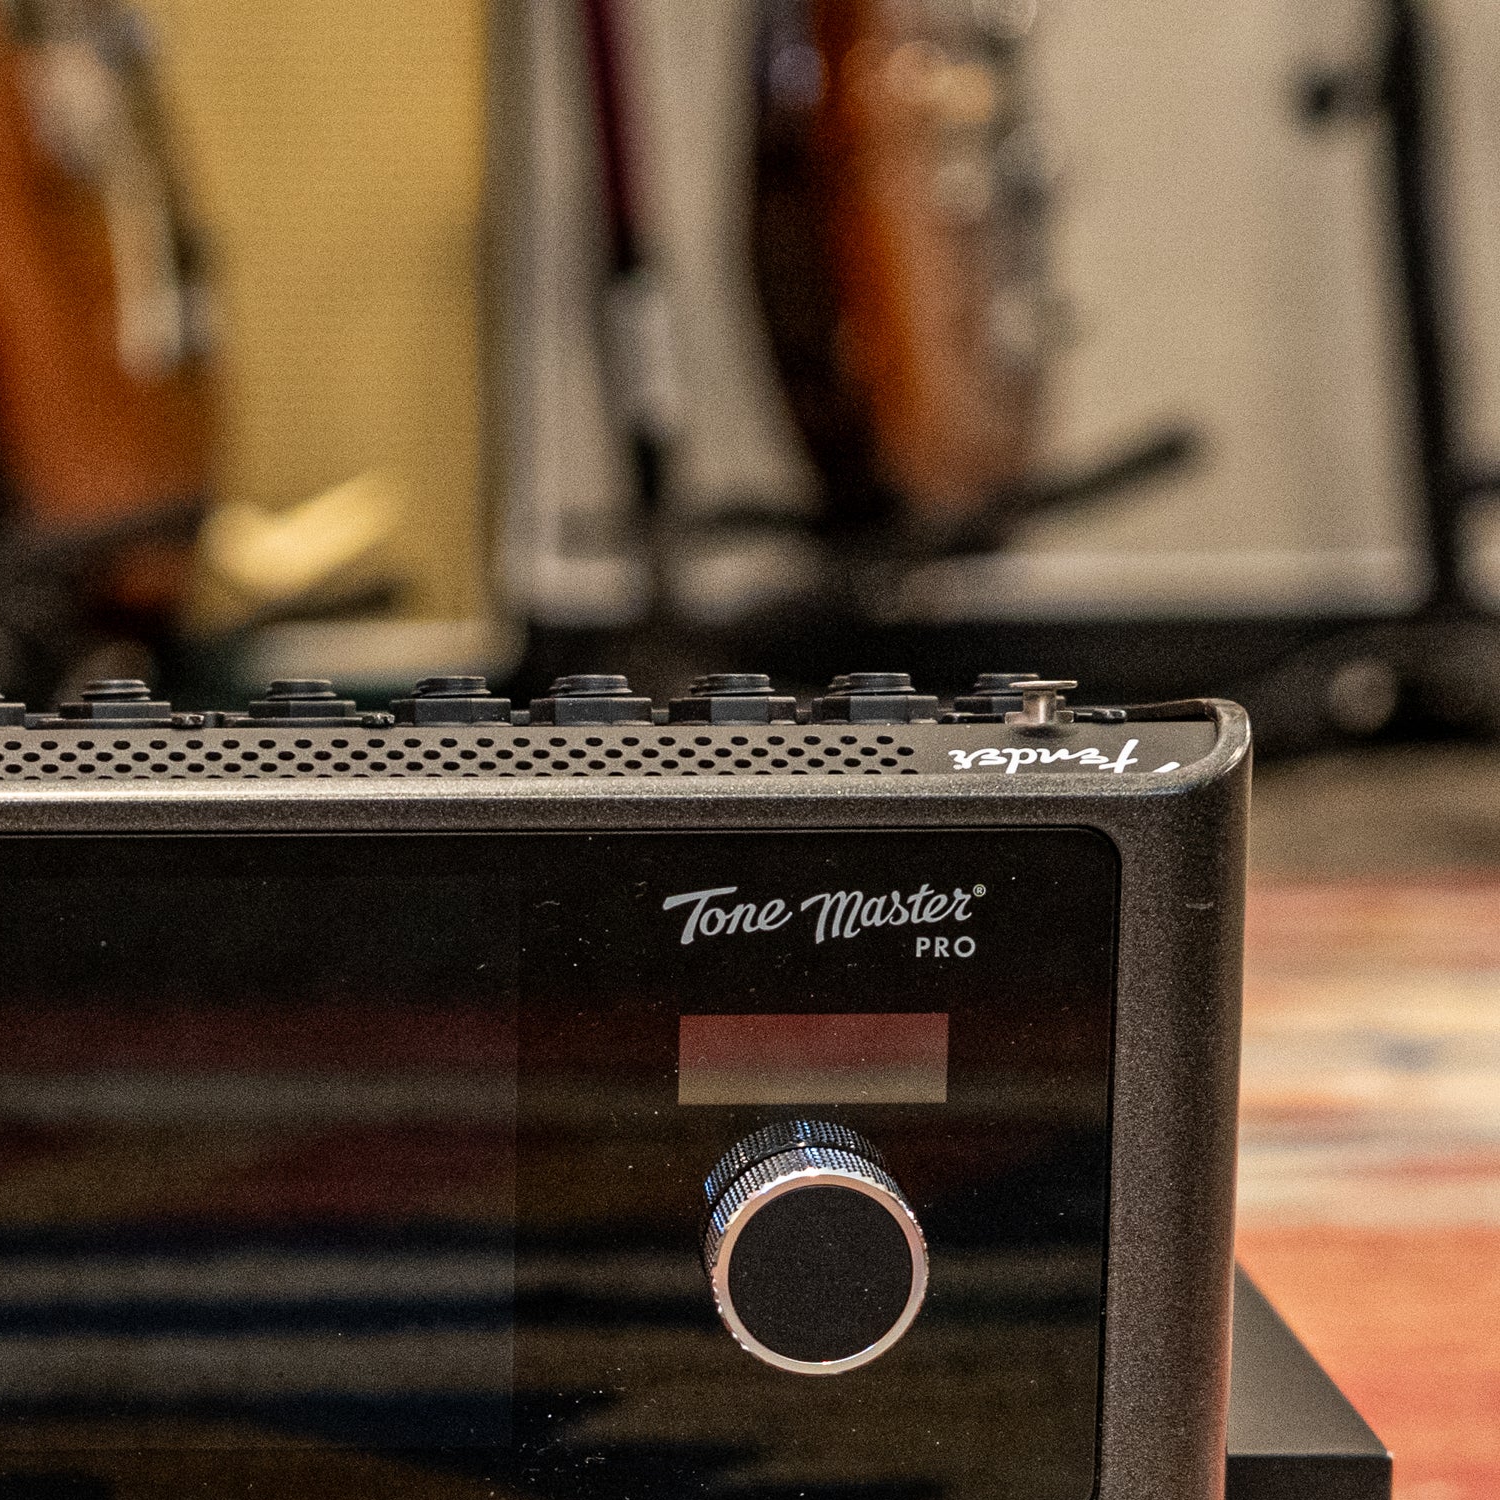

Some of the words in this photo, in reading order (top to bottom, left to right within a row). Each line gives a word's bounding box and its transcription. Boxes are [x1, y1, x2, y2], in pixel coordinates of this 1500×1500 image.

[662, 885, 793, 945] Tone
[800, 883, 972, 945] Master
[914, 936, 977, 958] PRO
